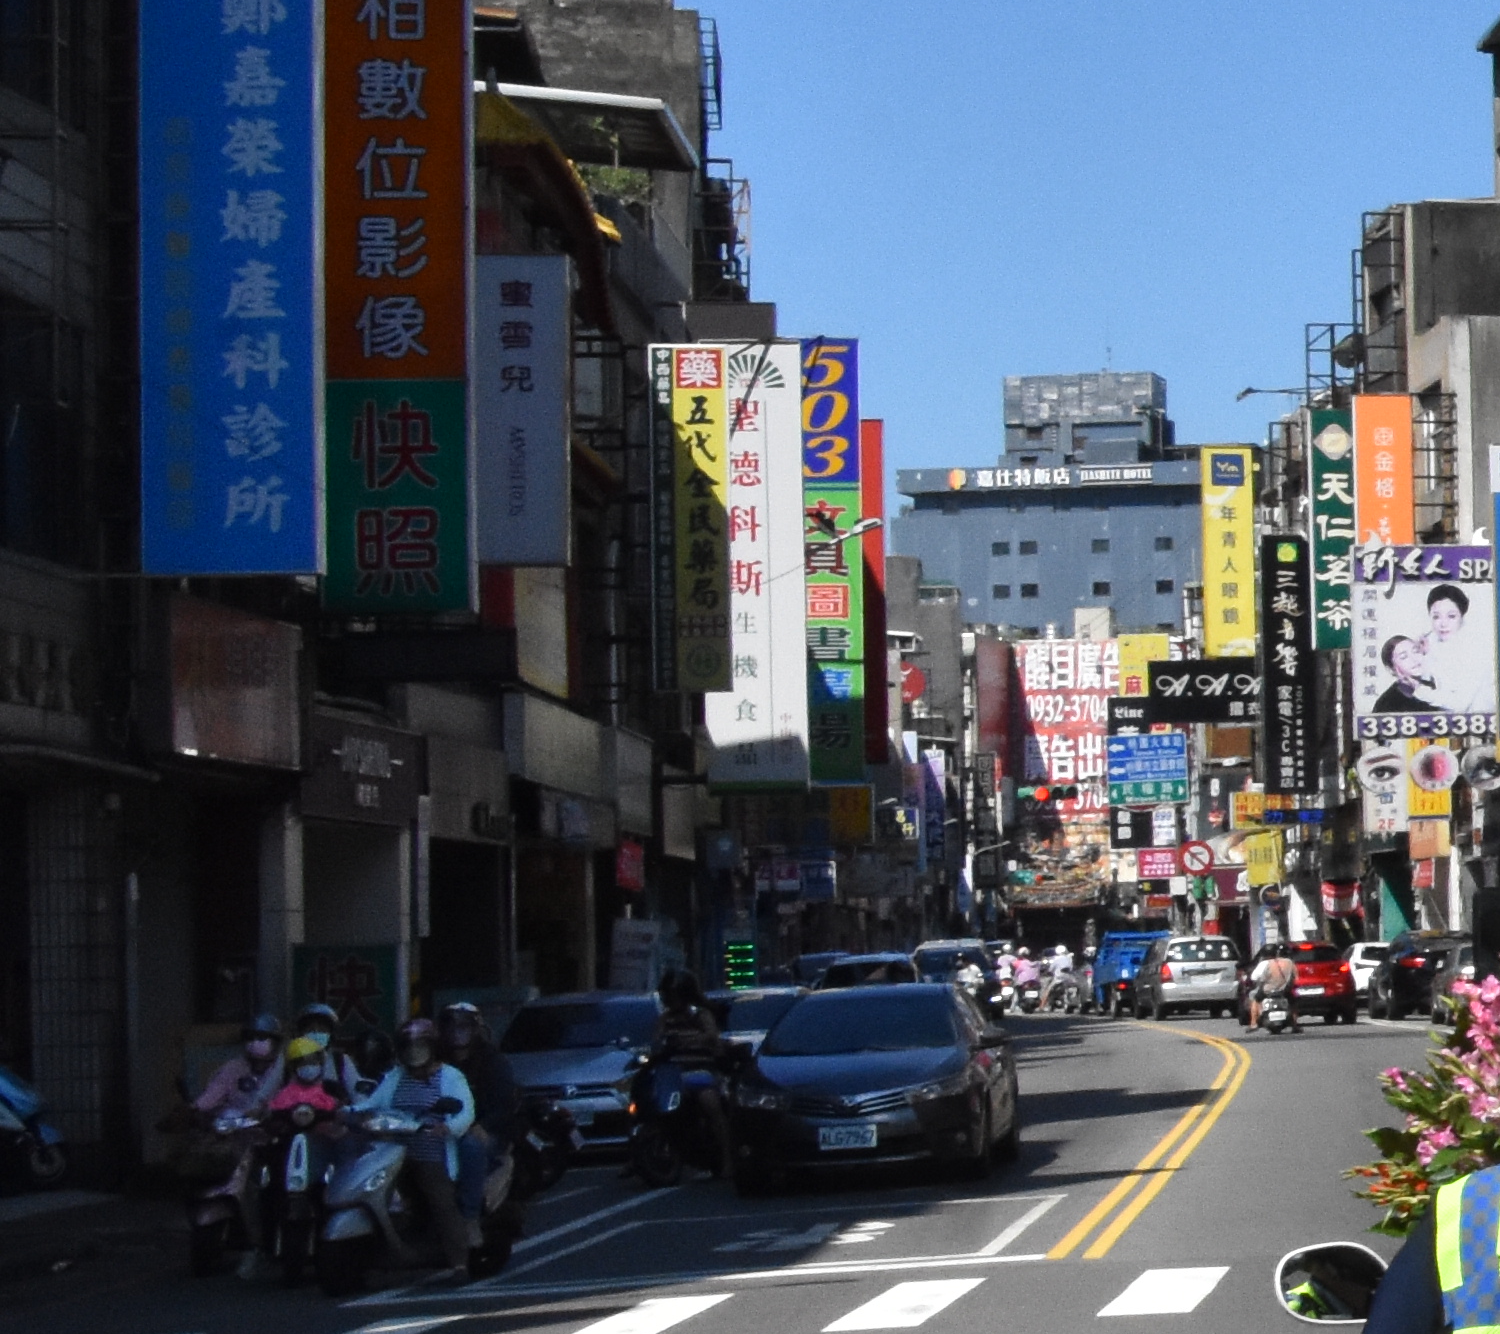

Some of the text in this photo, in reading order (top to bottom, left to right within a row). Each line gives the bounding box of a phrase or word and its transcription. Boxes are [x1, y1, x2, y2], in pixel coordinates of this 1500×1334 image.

[679, 351, 721, 388] 藥
[802, 345, 849, 478] 503
[349, 397, 441, 598] 快照
[729, 397, 762, 598] 聖德科斯
[976, 468, 1071, 488] 嘉仕特飯店
[1220, 506, 1241, 626] 年青人眼鏡
[1315, 472, 1354, 630] 天仁茗茶
[734, 612, 761, 766] 生機食品
[1376, 818, 1395, 831] 2F
